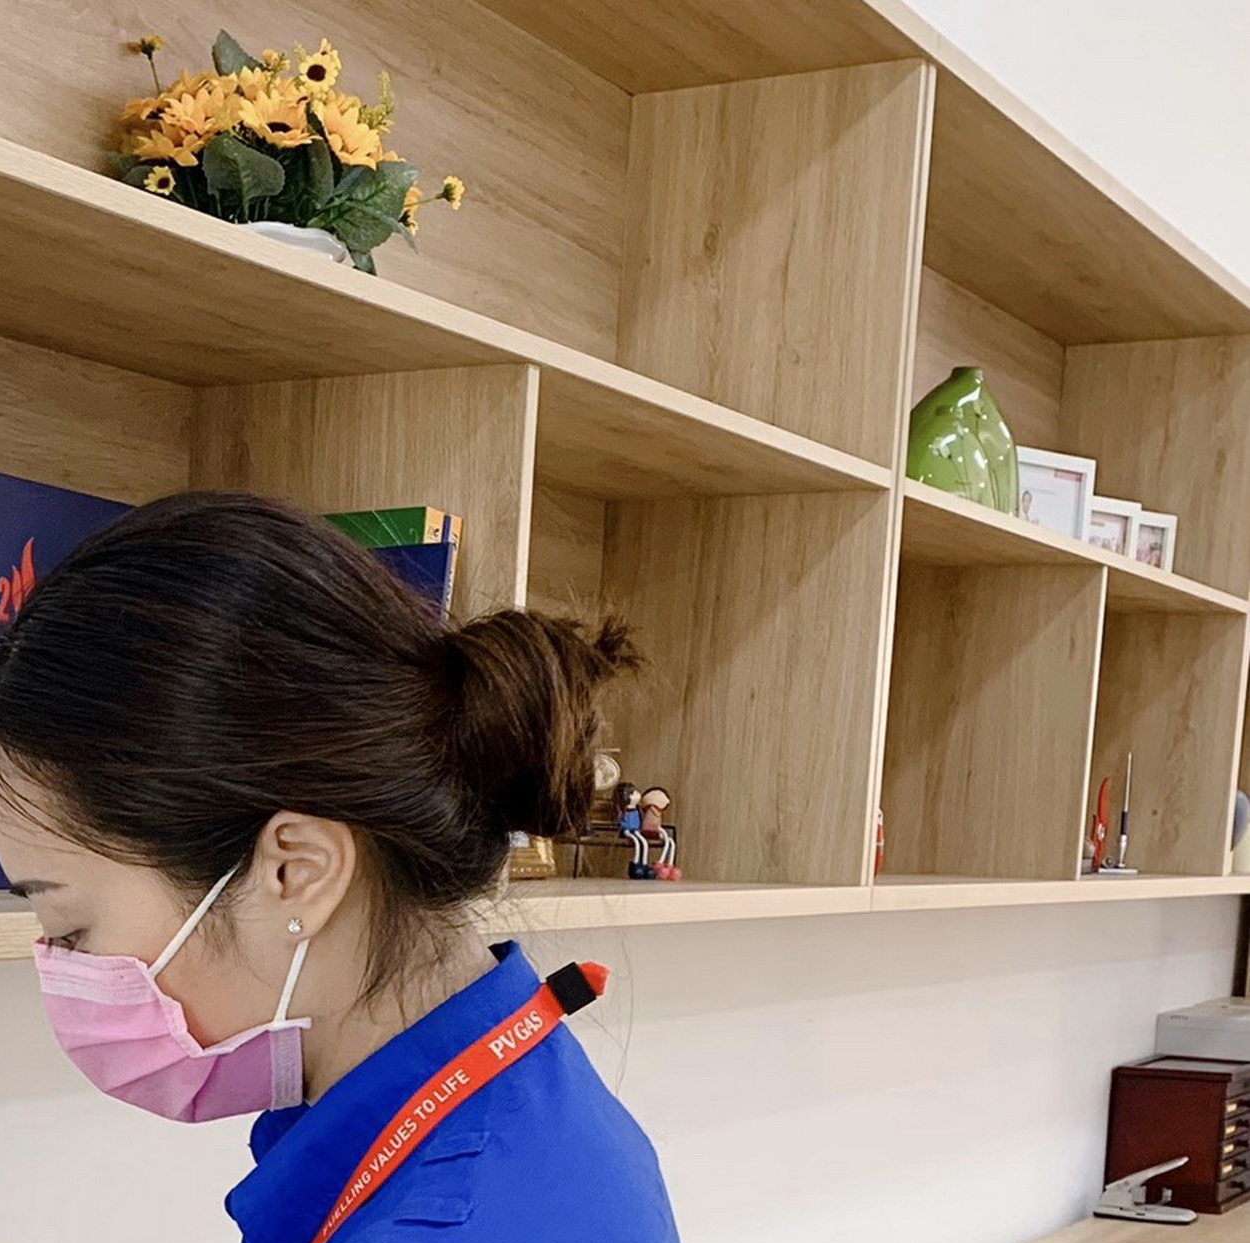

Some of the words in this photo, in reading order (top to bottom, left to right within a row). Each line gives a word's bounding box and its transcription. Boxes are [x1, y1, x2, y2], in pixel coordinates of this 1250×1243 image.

[488, 1030, 516, 1060] PV
[513, 1009, 543, 1041] GAS
[323, 1170, 371, 1236] FUELLING
[369, 1118, 417, 1172] VALUES
[413, 1098, 436, 1121] TO
[433, 1069, 471, 1103] LIFE
